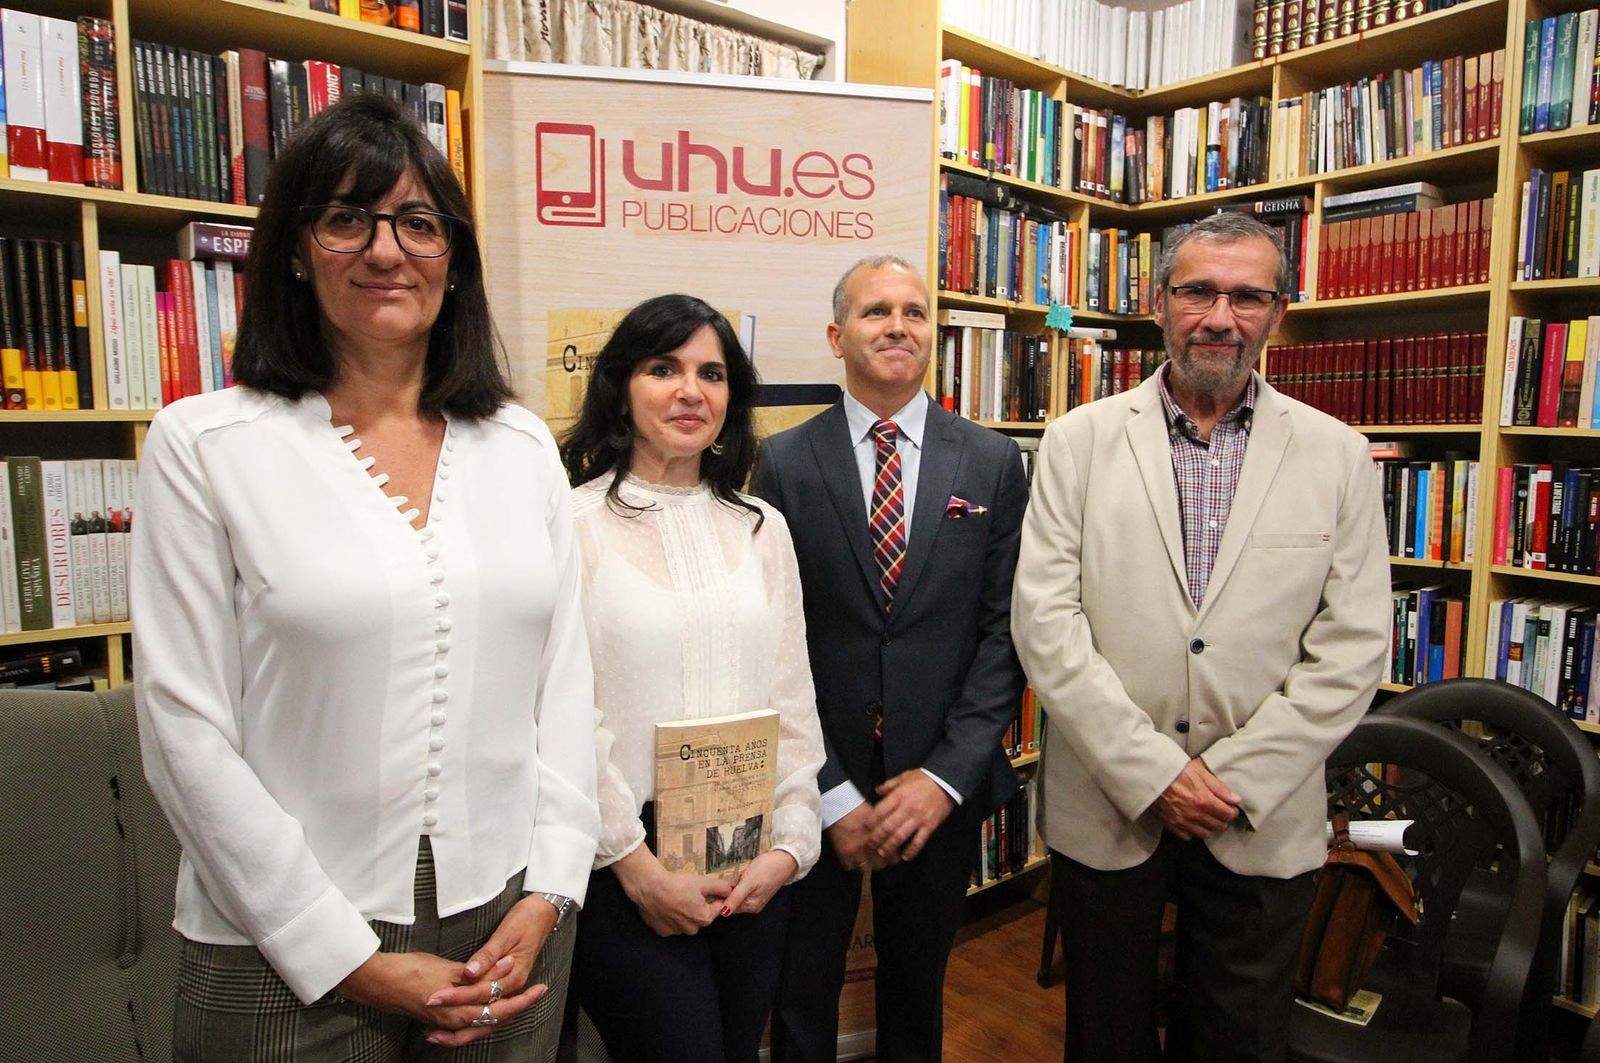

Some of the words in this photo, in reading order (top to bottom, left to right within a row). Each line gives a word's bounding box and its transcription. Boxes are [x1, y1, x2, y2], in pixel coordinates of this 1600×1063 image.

[86, 71, 100, 112] REDONDO
[90, 116, 103, 155] DOLORES
[622, 130, 876, 200] uhu.es
[622, 200, 874, 240] PUBLICACIONES
[1264, 199, 1300, 213] GEISHA
[20, 559, 30, 579] CIVIL
[51, 508, 71, 607] DESERTORES
[30, 557, 43, 596] ESPAÑOLA
[22, 580, 33, 612] GUERRA
[680, 744, 741, 760] CINCUENTA
[745, 739, 768, 751] AÑOS
[698, 759, 711, 769] EN
[716, 757, 728, 766] LA
[733, 750, 767, 764] PRENSA
[706, 769, 719, 778] DE
[724, 760, 764, 776] HUELVA:
